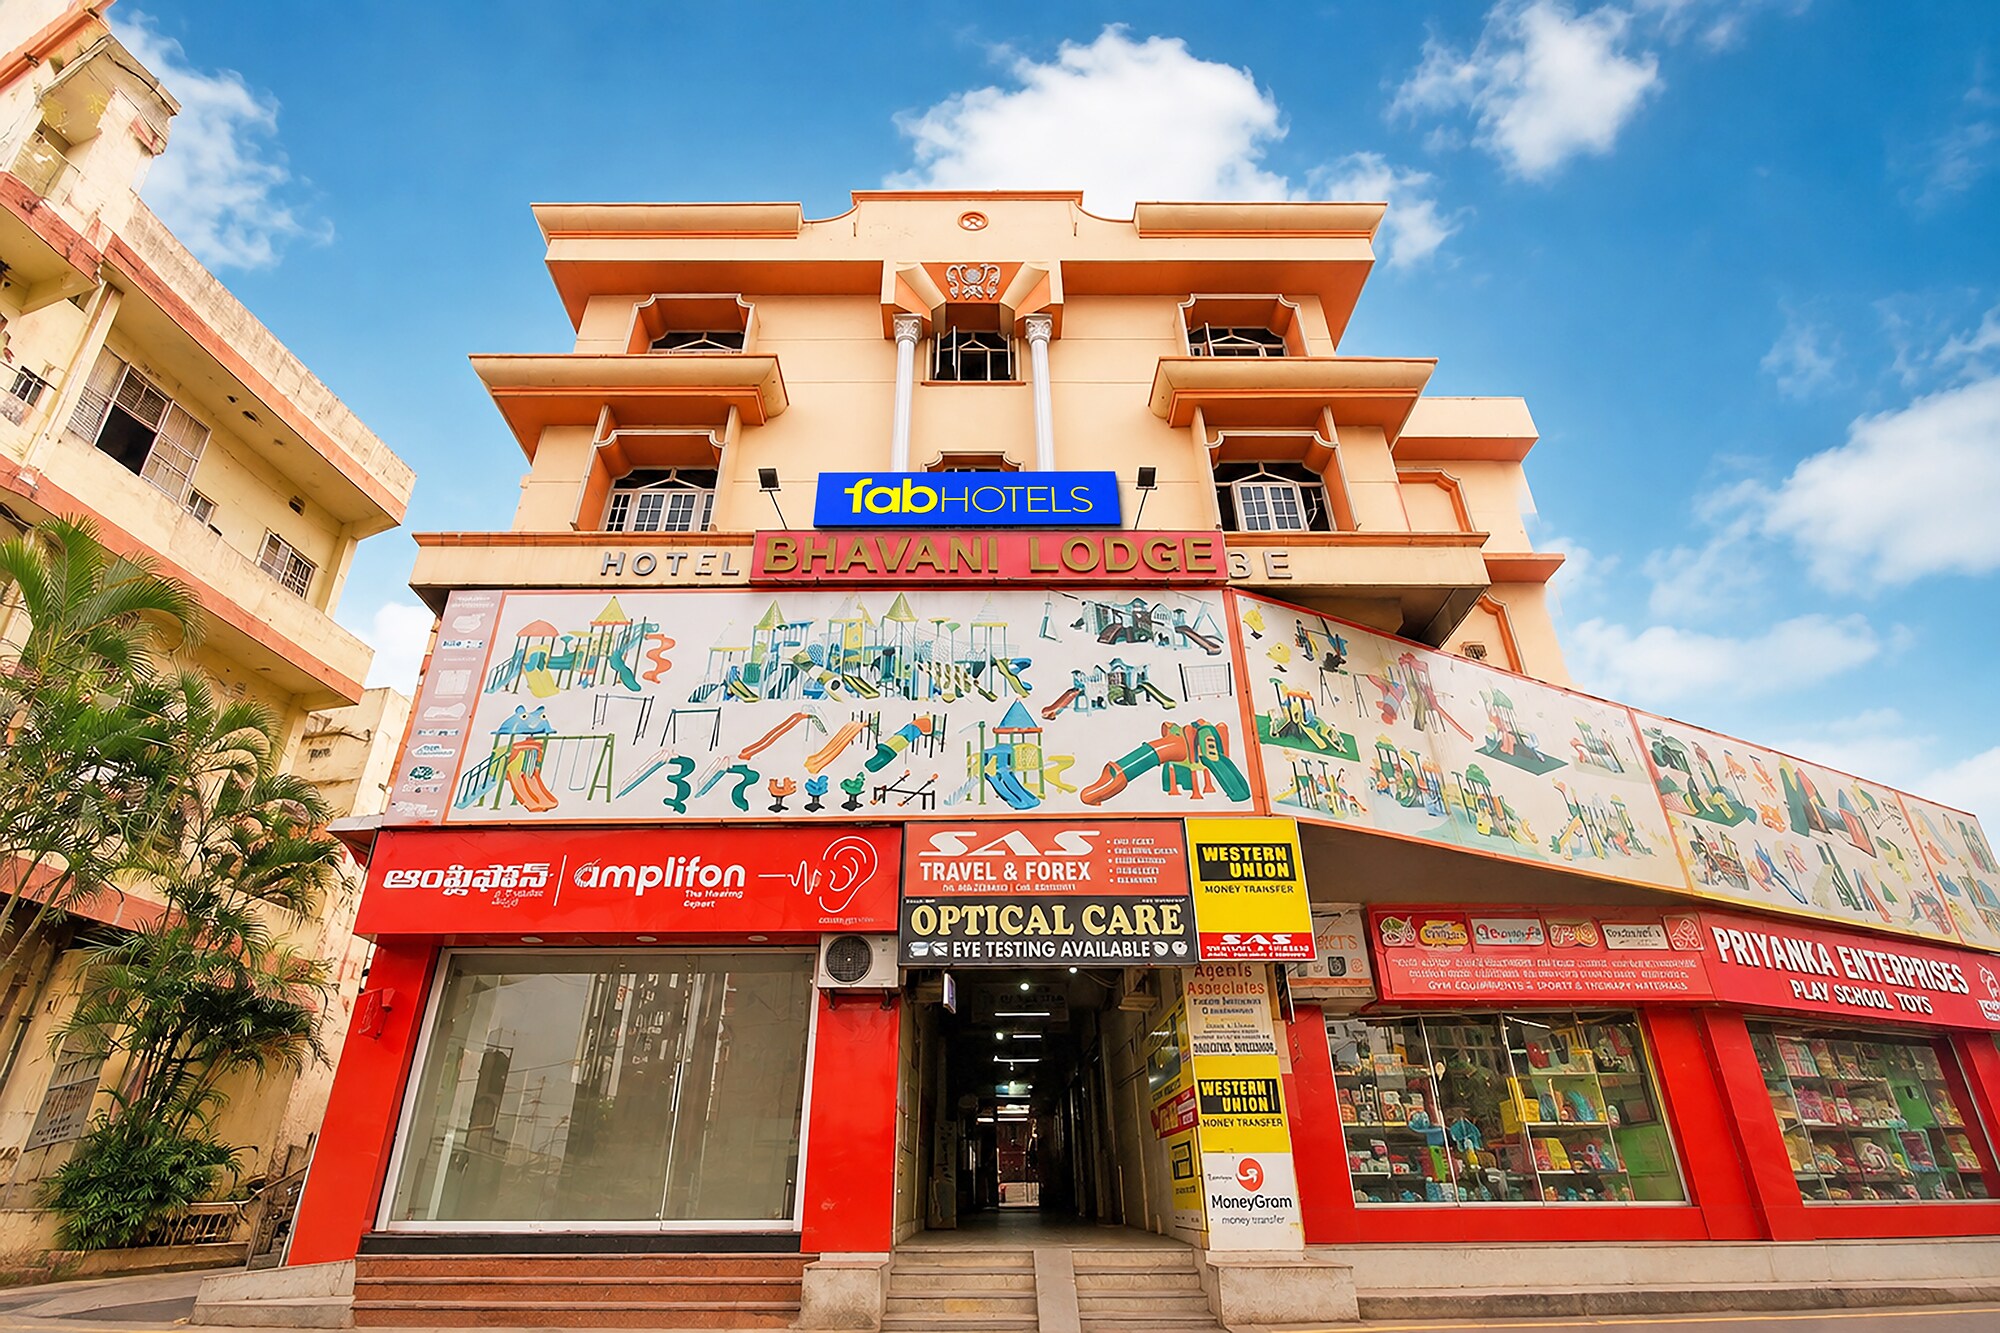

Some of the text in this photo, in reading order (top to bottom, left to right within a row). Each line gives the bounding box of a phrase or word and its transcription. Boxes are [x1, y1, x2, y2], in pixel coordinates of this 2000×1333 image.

[844, 478, 1093, 513] fabHOTELS
[763, 536, 1217, 573] BHAVANI LODGE
[601, 552, 740, 576] HOTEL
[918, 830, 1100, 856] SAS
[1202, 846, 1287, 861] WESTERN
[574, 856, 746, 896] amplifon
[920, 861, 1091, 881] TRAVEL & FOREX
[1229, 862, 1290, 878] UNION
[1205, 885, 1294, 893] MONEY TRANSFER
[911, 904, 1185, 936] OPTICAL CARE
[1220, 934, 1292, 945] SAS
[953, 941, 1150, 958] EYE TESTING AVAILABLE
[1711, 927, 1839, 977] PRIYANKA
[1836, 945, 1970, 994] ENTERPRISES
[1790, 980, 1933, 1014] PLAY SCHOOL TOYS
[1201, 1080, 1267, 1096] WESTERN
[1222, 1096, 1269, 1112] UNION
[1237, 1117, 1284, 1127] TRANSFER
[1211, 1194, 1293, 1211] MoneyGram
[1221, 1216, 1251, 1226] money
